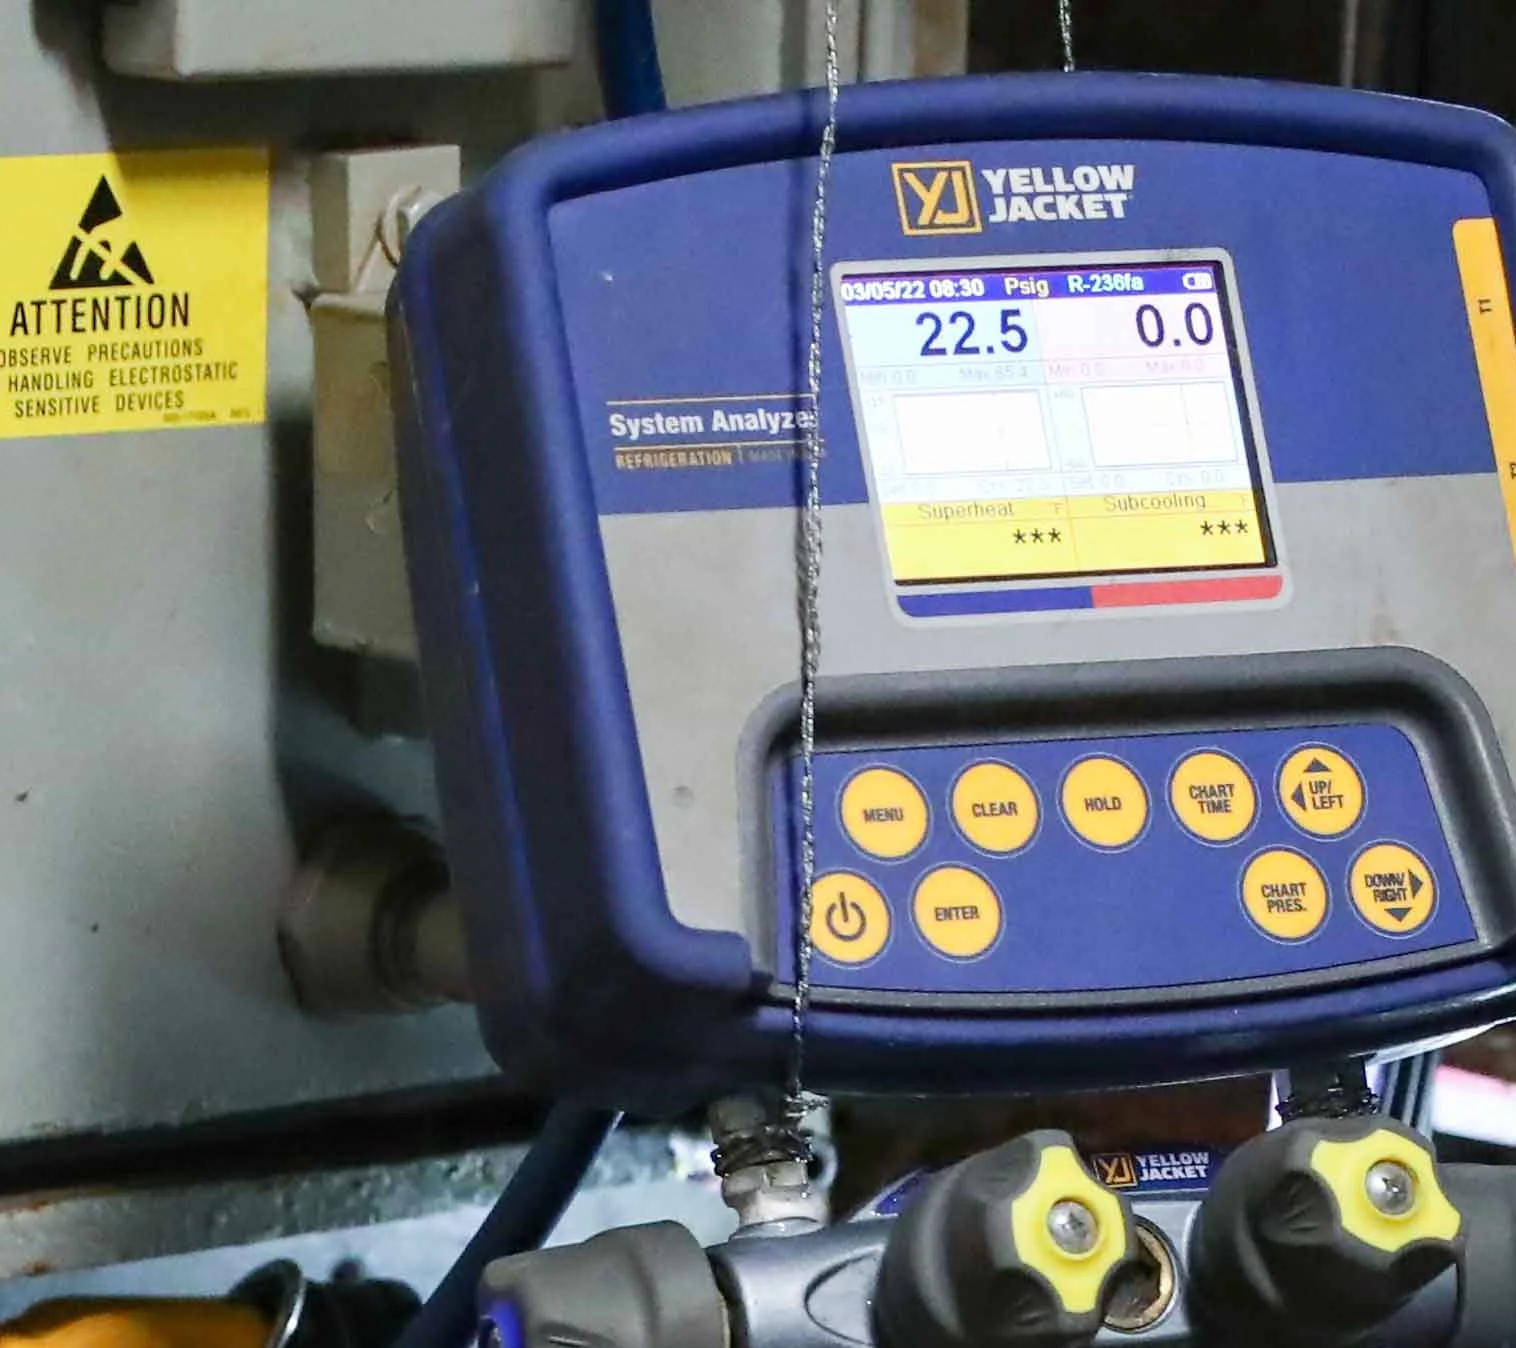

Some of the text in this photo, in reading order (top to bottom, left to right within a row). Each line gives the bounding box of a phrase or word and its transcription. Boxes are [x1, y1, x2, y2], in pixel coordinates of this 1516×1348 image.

[981, 164, 1135, 194] YELLOW
[988, 193, 1131, 223] JACKET
[841, 273, 1145, 301] 03/05/22 08:30 Psig R-236fa
[9, 291, 190, 337] ATTENTION
[1478, 298, 1492, 314] T1
[915, 308, 1029, 357] 22.5
[1135, 302, 1214, 348] 0.0
[87, 337, 204, 362] PRECAUTIONS
[8, 369, 94, 394] HANDLING
[109, 361, 239, 387] ELECTROSTATIC
[14, 390, 185, 419] SENSITIVE DEVICES
[608, 411, 705, 440] System
[614, 446, 733, 469] REFRIGERATION
[917, 501, 1015, 522] Superheat
[1104, 493, 1207, 513] Subcooling
[1188, 783, 1235, 800] CHART
[1308, 780, 1333, 795] UP/
[971, 801, 1018, 818] CLEAR
[1084, 796, 1122, 812] HOLD
[1198, 799, 1232, 815] TIME
[1311, 794, 1344, 811] LEFT
[863, 807, 904, 823] MENU
[1364, 871, 1406, 889] DOWN/
[1260, 881, 1308, 899] CHART
[1373, 887, 1409, 905] RIGHT
[934, 905, 981, 922] ENTER
[1266, 897, 1308, 913] PRES.
[1135, 1151, 1210, 1167] YELLOW
[1139, 1165, 1208, 1181] JACKET
